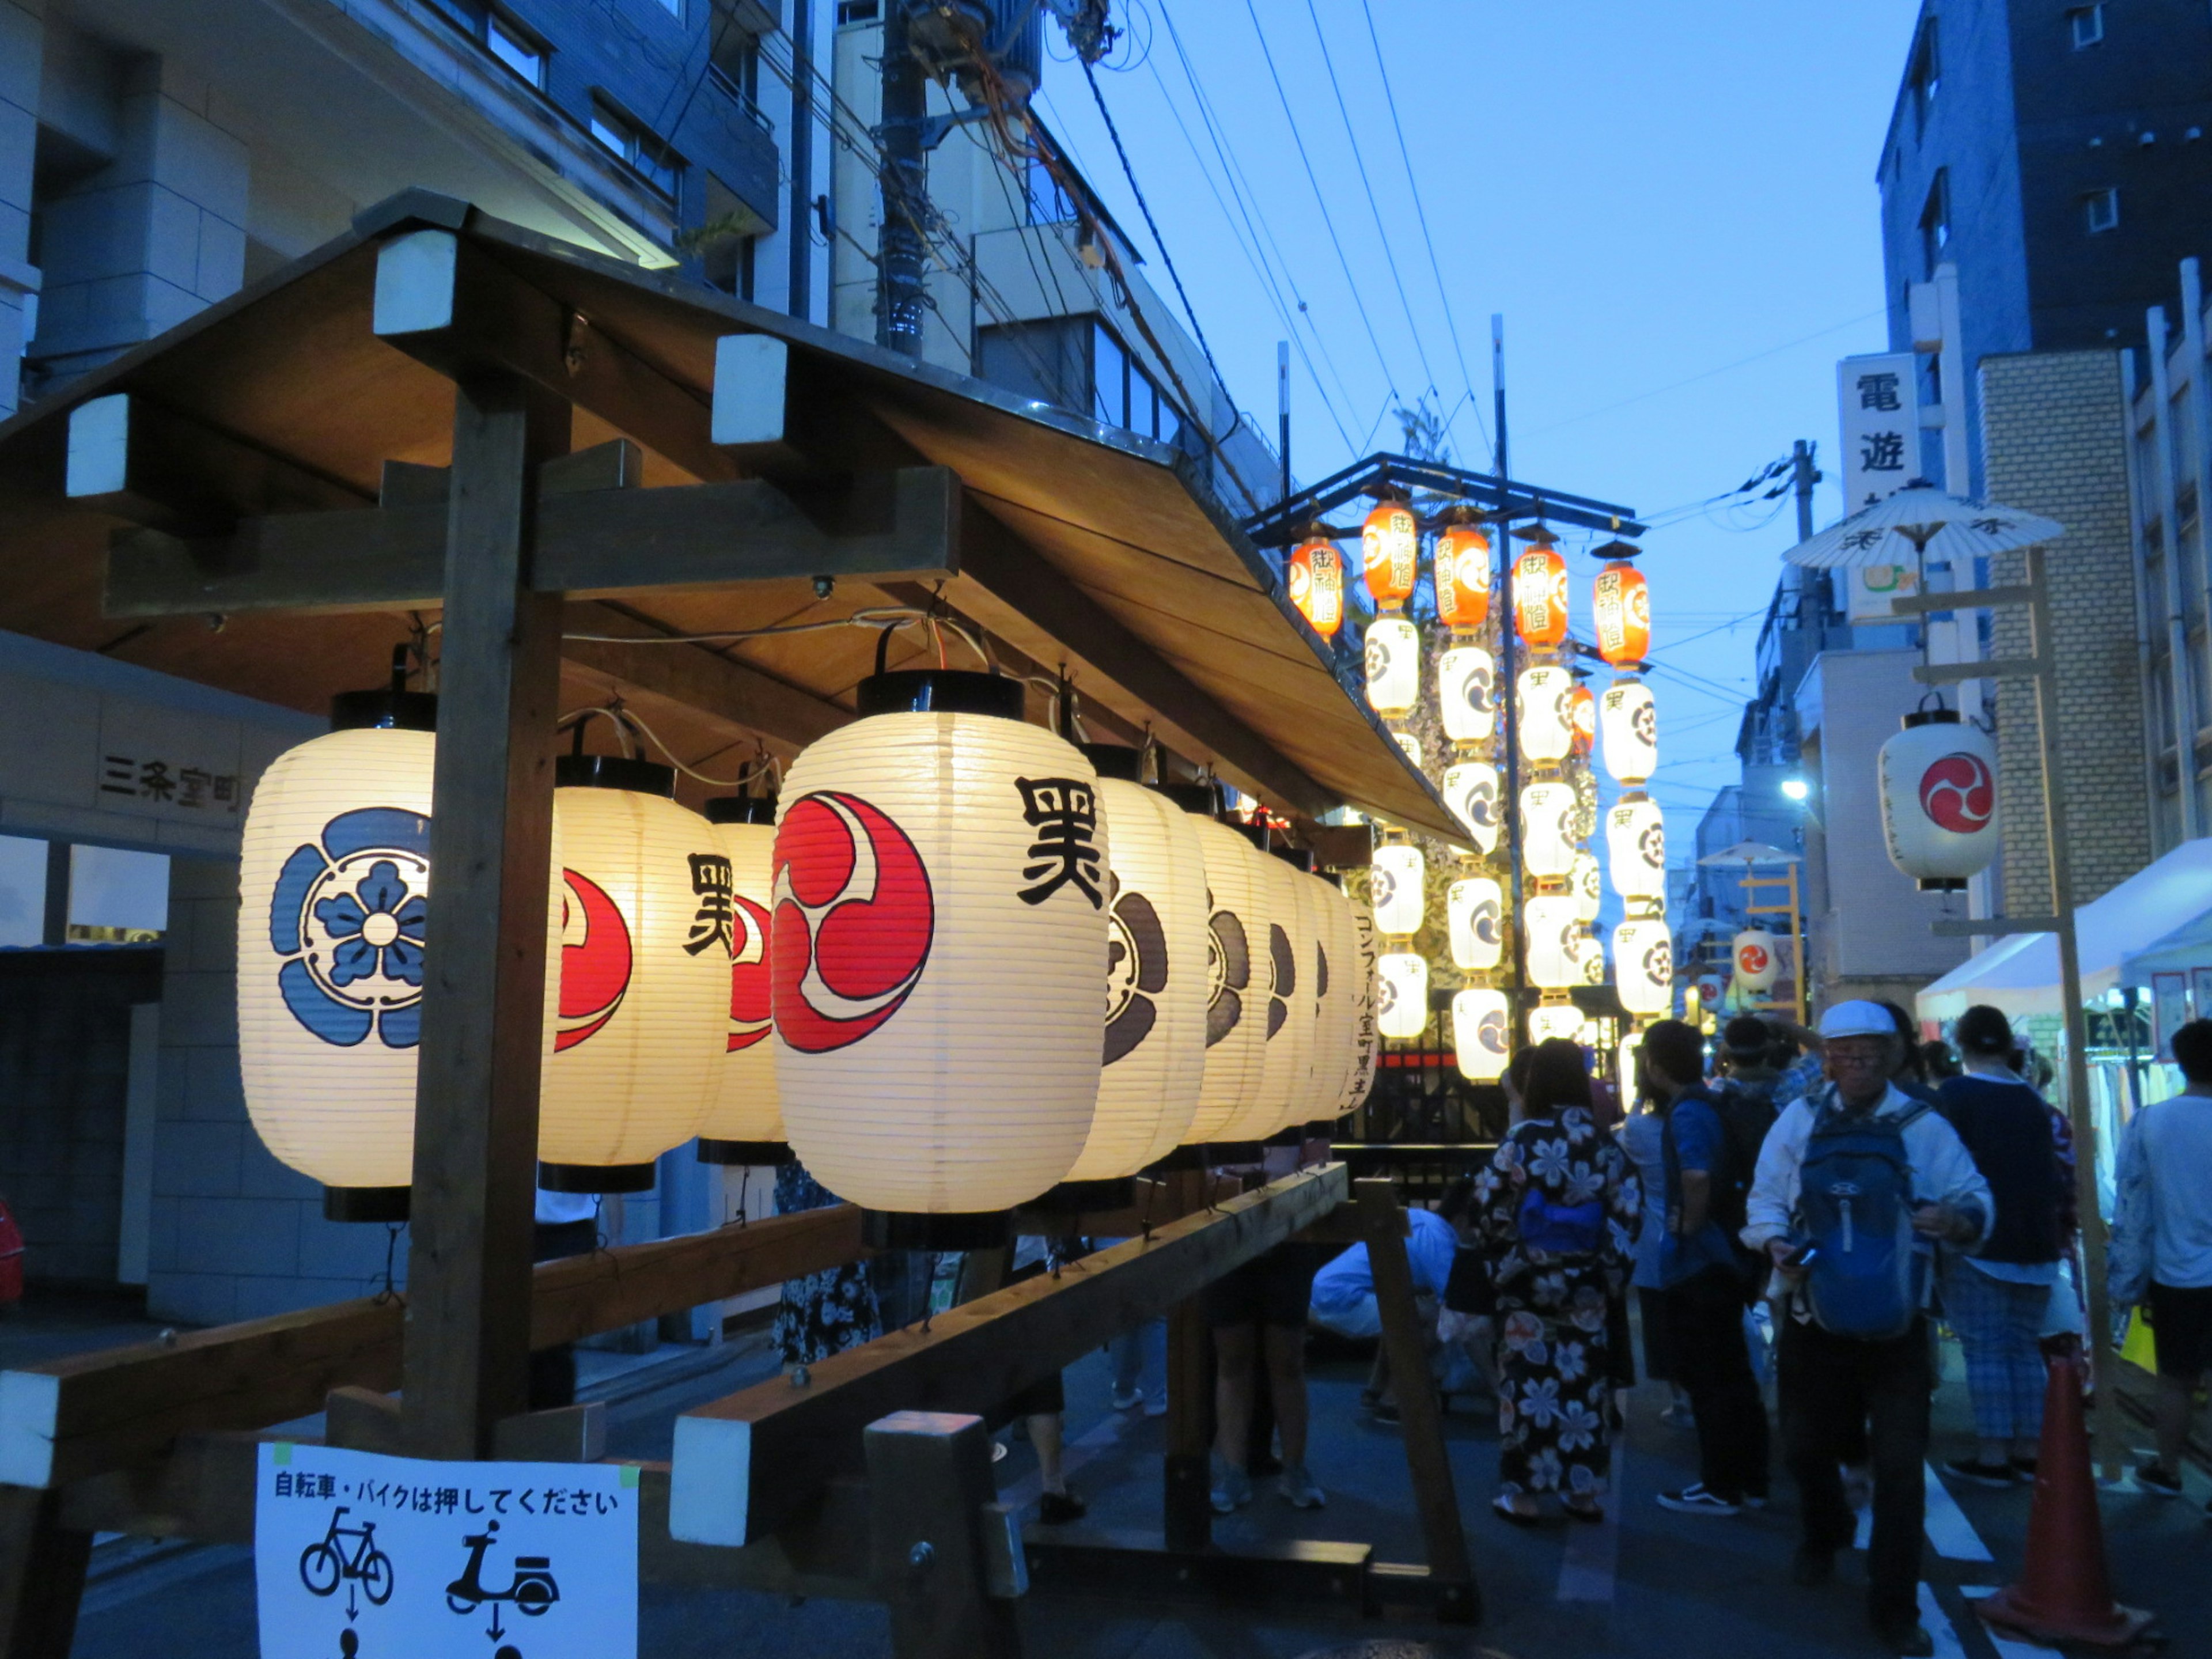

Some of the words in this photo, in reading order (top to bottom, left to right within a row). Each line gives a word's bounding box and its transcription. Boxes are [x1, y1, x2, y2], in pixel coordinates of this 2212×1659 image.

[100, 755, 241, 813] 三条室町
[274, 1470, 618, 1516] 自転車・バイクは押してください
